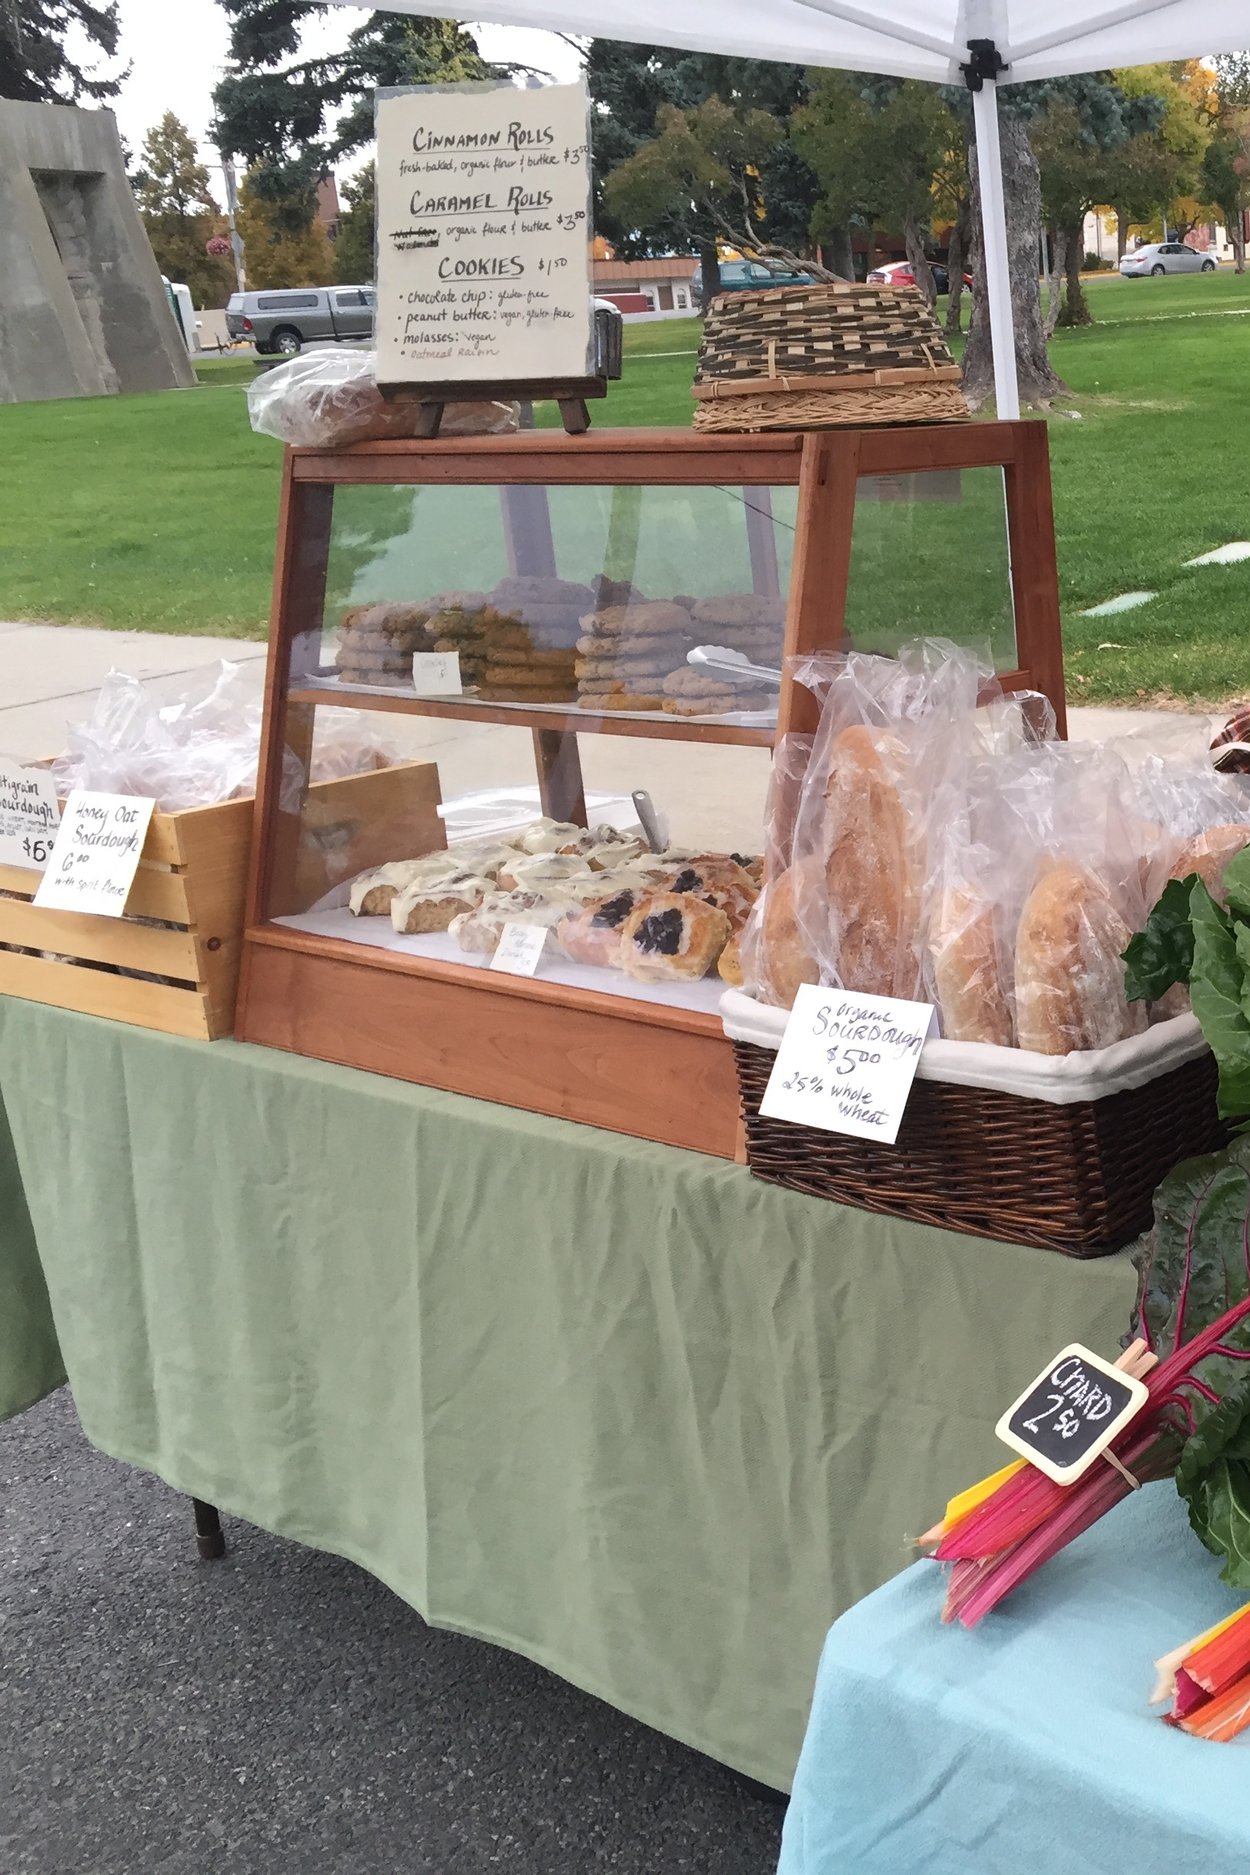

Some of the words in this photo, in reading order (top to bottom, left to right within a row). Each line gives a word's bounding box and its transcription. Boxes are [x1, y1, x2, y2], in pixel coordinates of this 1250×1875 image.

[507, 121, 554, 151] ROLLS
[399, 158, 458, 177] fresh-baked,
[460, 161, 490, 177] organic
[410, 190, 498, 215] CARAMEL
[507, 186, 553, 215] ROLLS
[446, 226, 477, 242] organic
[438, 255, 525, 279] COOKIES
[407, 289, 457, 304] chocolate
[404, 308, 448, 334] peanut
[403, 331, 459, 345] molasses:
[0, 798, 54, 826] ourdough
[76, 800, 110, 835] Honey
[115, 805, 140, 823] Oat
[72, 823, 139, 858] Sourdough
[782, 1071, 823, 1094] 25%
[830, 1082, 873, 1105] whole
[838, 1101, 890, 1126] wheat
[1051, 1358, 1112, 1420] CHARD
